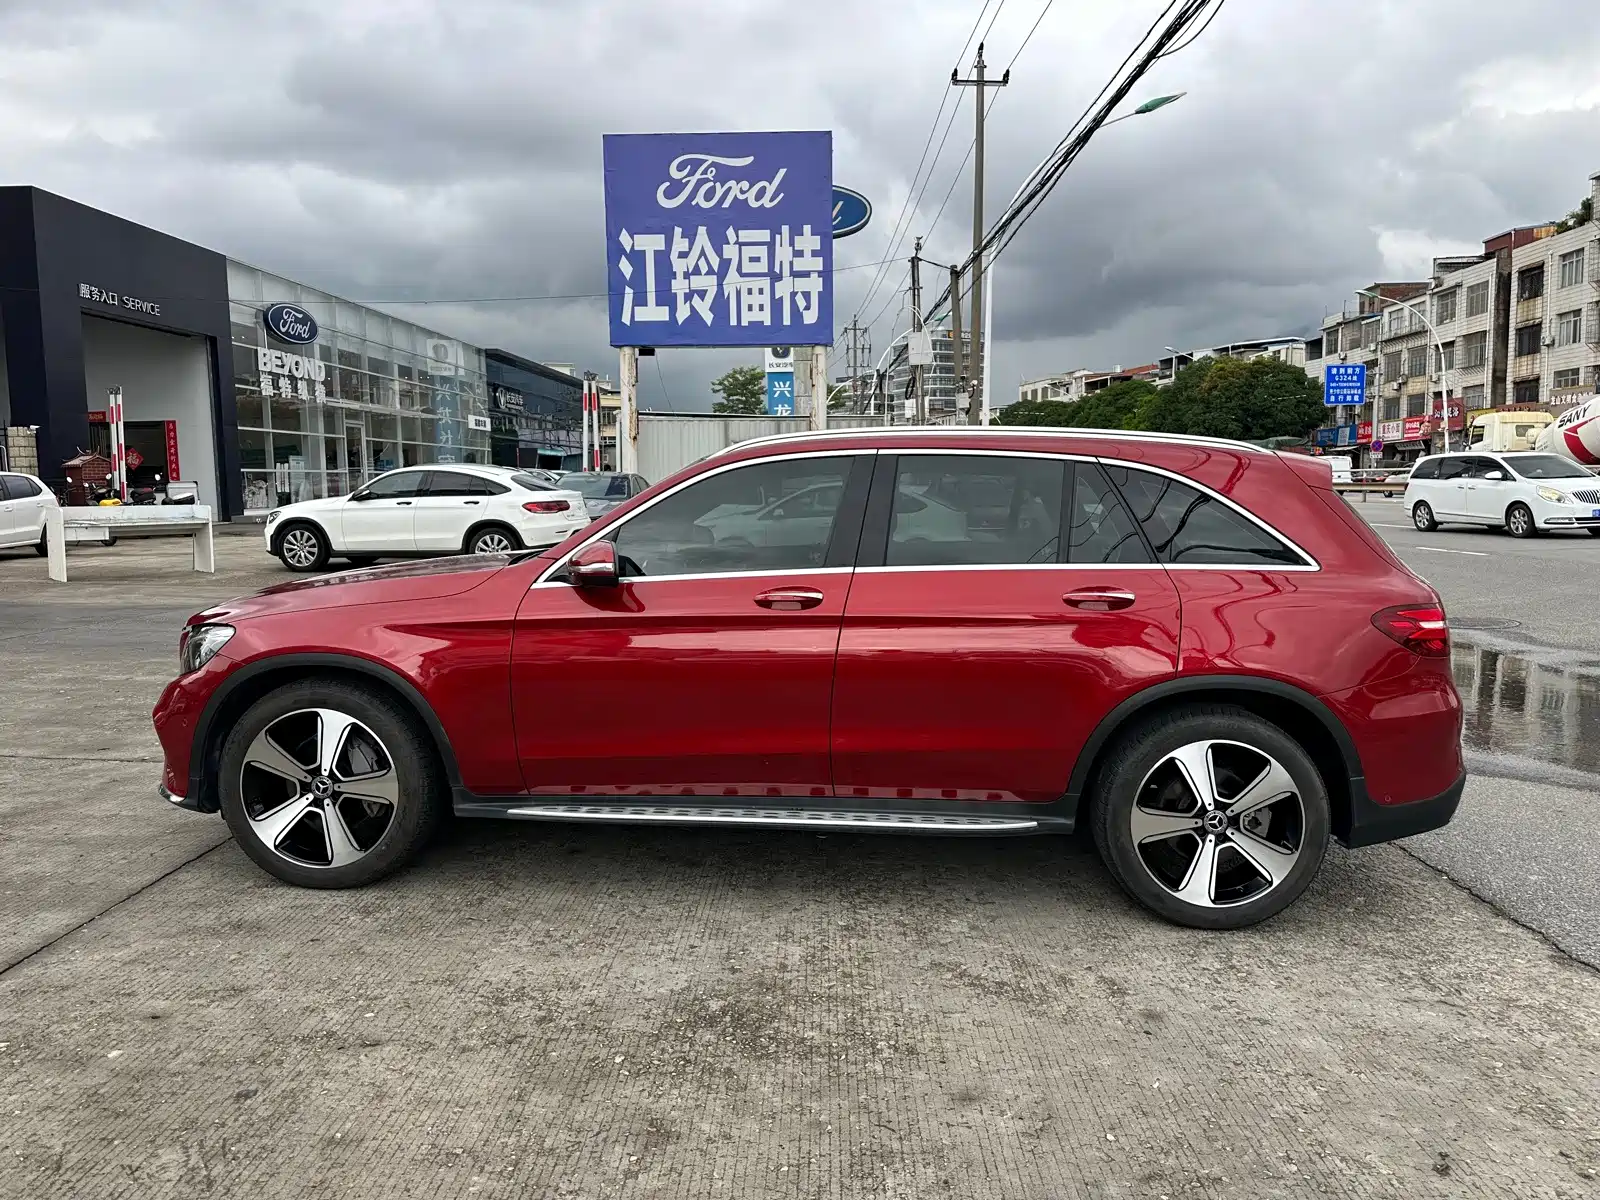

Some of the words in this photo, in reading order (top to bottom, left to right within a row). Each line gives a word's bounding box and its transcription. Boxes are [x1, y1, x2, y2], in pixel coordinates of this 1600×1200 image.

[656, 153, 787, 209] Ford
[618, 224, 824, 327] 江铃福特
[79, 283, 118, 306] 服务入口
[122, 296, 160, 316] SERVICE
[280, 308, 311, 338] Ford
[258, 346, 326, 382] BEYOND
[1557, 404, 1591, 429] SANY
[127, 452, 139, 464] 福
